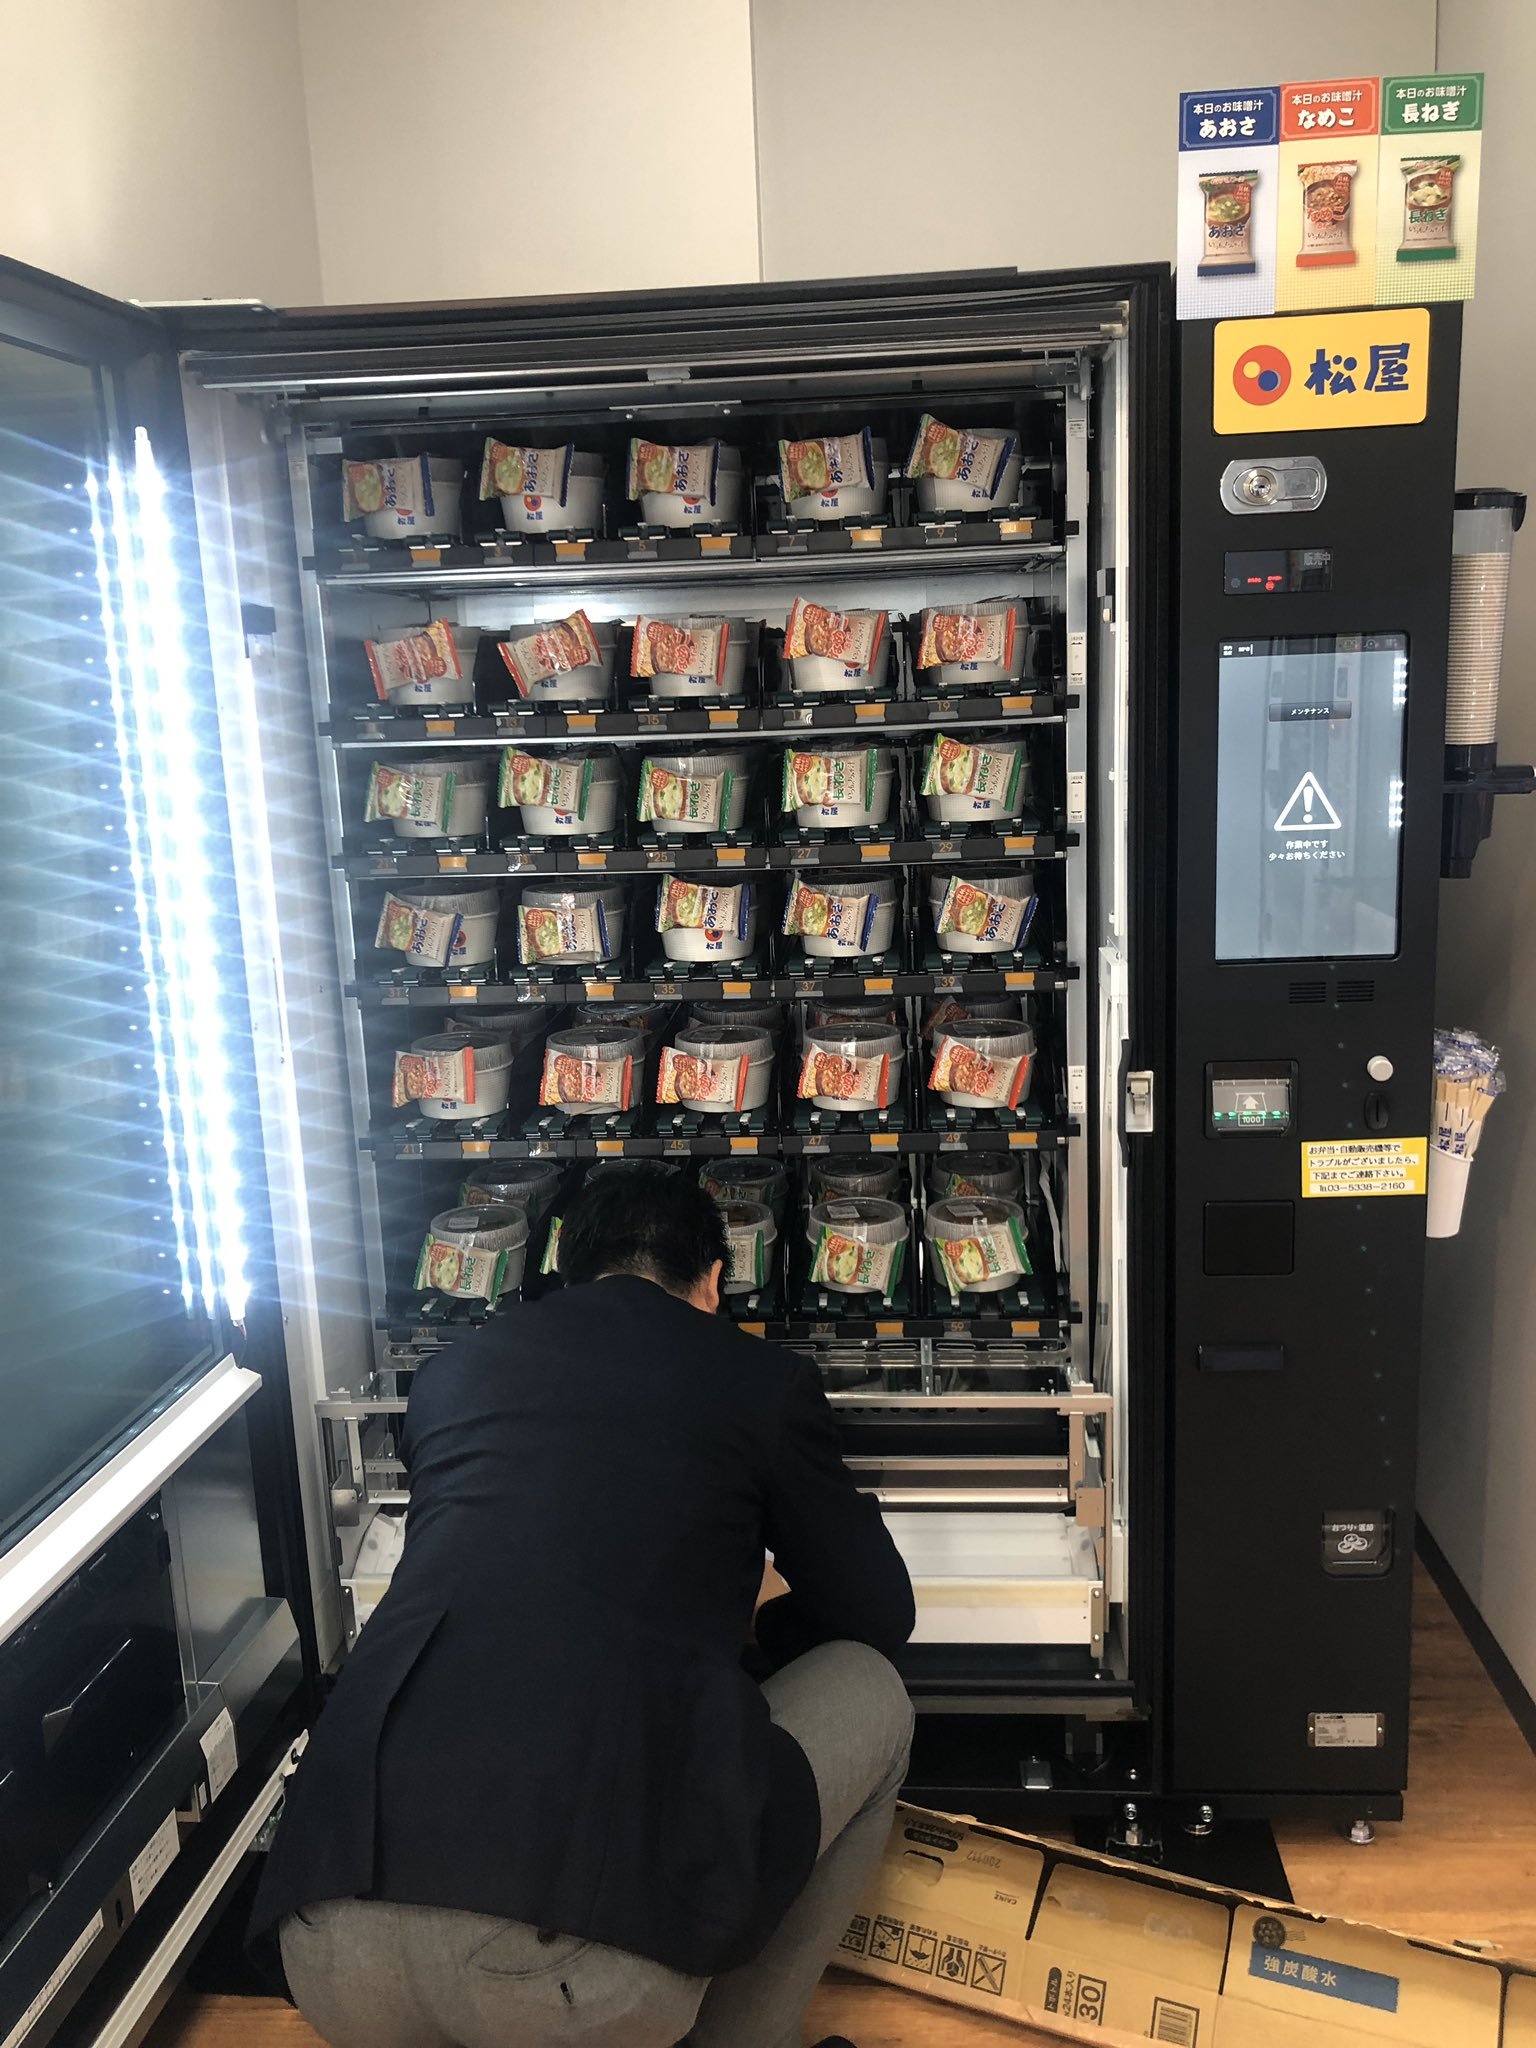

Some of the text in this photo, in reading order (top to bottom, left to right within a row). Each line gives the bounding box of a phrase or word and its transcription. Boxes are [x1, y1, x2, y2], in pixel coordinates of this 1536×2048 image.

[1292, 90, 1363, 105] 本日のお味噌汁
[1396, 85, 1467, 100] 本日のお味噌汁
[1193, 99, 1264, 115] 本日のお味噌汁
[1297, 107, 1355, 130] なめこ
[1401, 101, 1461, 125] 長ねぎ
[1199, 116, 1257, 140] あおさ
[1409, 208, 1447, 224] 長ねぎ
[1208, 224, 1245, 239] あおさ
[1304, 342, 1411, 396] 松屋
[957, 441, 979, 481] あおさ
[524, 452, 539, 493] あおさ
[674, 451, 690, 492] あおさ
[684, 505, 702, 514] 松屋
[960, 661, 979, 671] 松屋
[844, 668, 862, 678] 松屋
[1291, 708, 1330, 716] メンテナンス
[976, 753, 992, 794] 長ねぎ
[833, 761, 845, 800] 長ねぎ
[689, 781, 700, 819] 長ねぎ
[973, 800, 991, 809] 松屋
[821, 807, 839, 816] 松屋
[555, 815, 573, 825] 松屋
[940, 841, 953, 852] 29
[1286, 839, 1328, 850] 作業中です
[654, 852, 668, 862] 25
[797, 849, 811, 859] 27
[1268, 850, 1346, 862] 少々お待ちください
[826, 903, 843, 940] あおさ
[984, 902, 1006, 939] あおさ
[412, 917, 428, 954] あおさ
[706, 941, 723, 950] 松屋
[802, 981, 815, 992] 37
[942, 977, 955, 987] 39
[662, 985, 676, 994] 35
[441, 1101, 457, 1110] 松屋
[1243, 1116, 1261, 1124] 1000
[809, 1135, 822, 1146] 47
[946, 1133, 960, 1143] 49
[670, 1140, 684, 1150] 45
[1309, 1156, 1417, 1168] トラブルがございましたら、
[1313, 1169, 1404, 1180] 下記までご連絡下さい。
[857, 1250, 875, 1285] 長ねぎ
[460, 1256, 476, 1291] 長ねぎ
[816, 1323, 828, 1333] 57
[951, 1321, 964, 1332] 59
[1264, 1954, 1338, 1988] 強炭酸水
